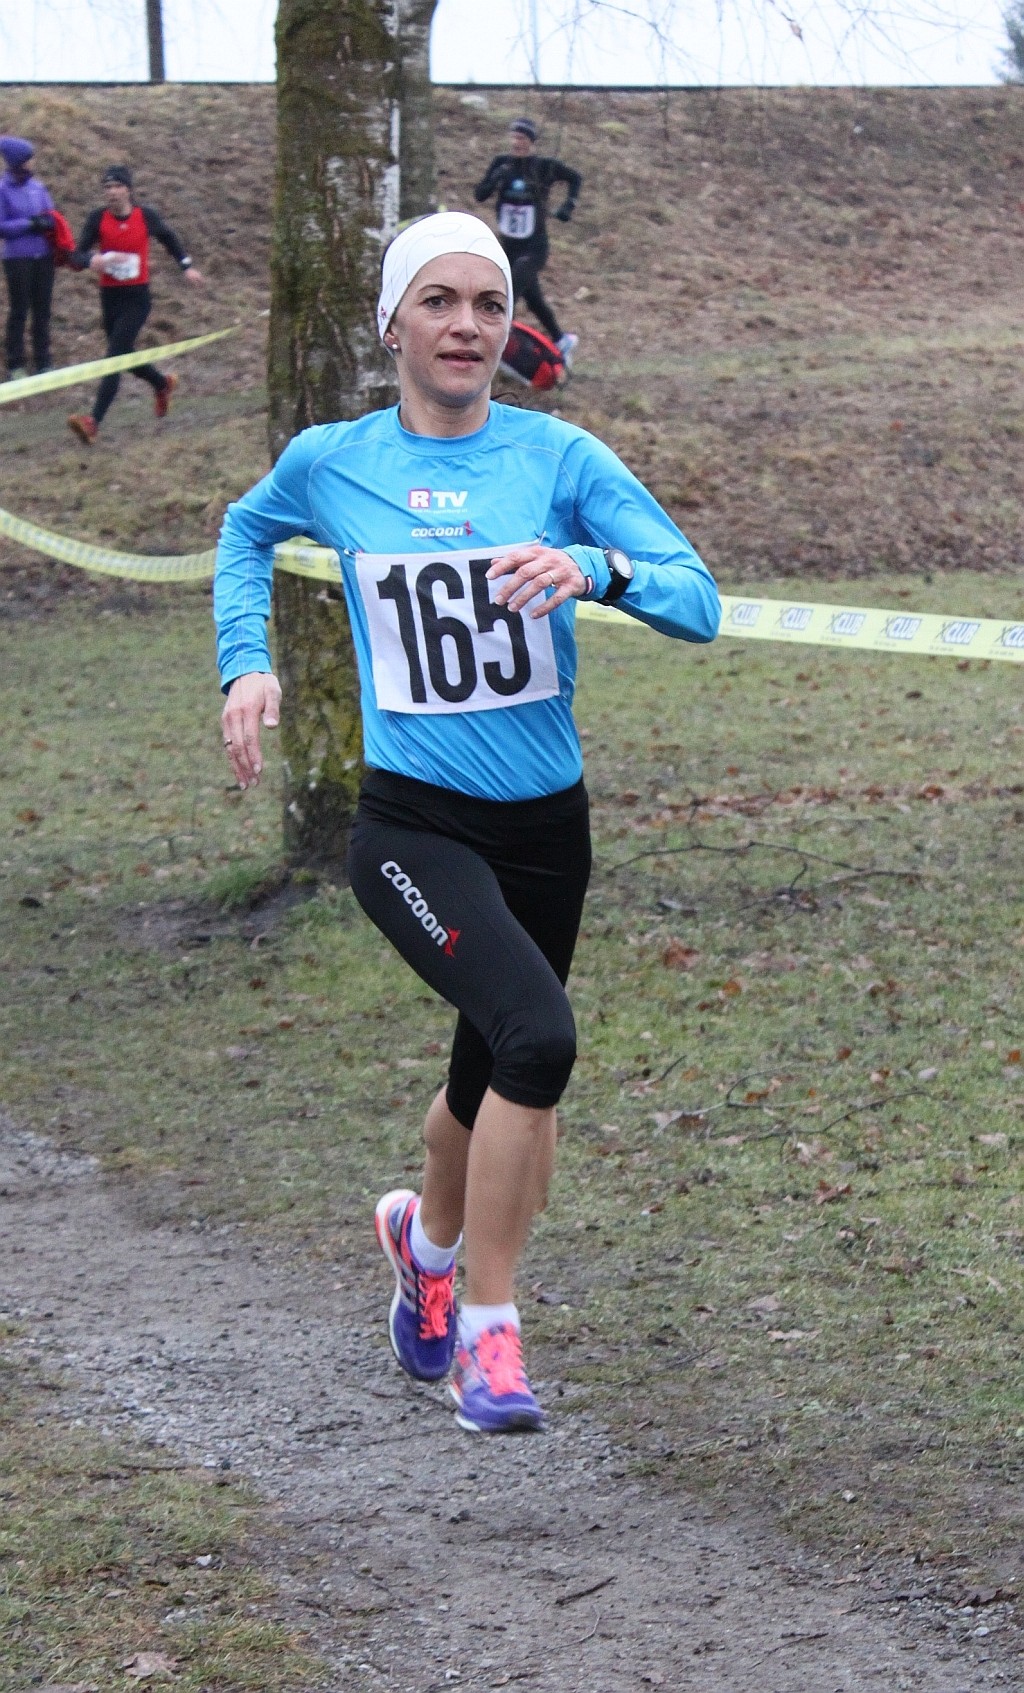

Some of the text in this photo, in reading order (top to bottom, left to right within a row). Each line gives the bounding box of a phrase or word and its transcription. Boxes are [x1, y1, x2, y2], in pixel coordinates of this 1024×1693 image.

[409, 490, 469, 508] RTV
[410, 526, 465, 538] cocoon
[376, 557, 532, 704] 165
[380, 860, 449, 947] cocoon
